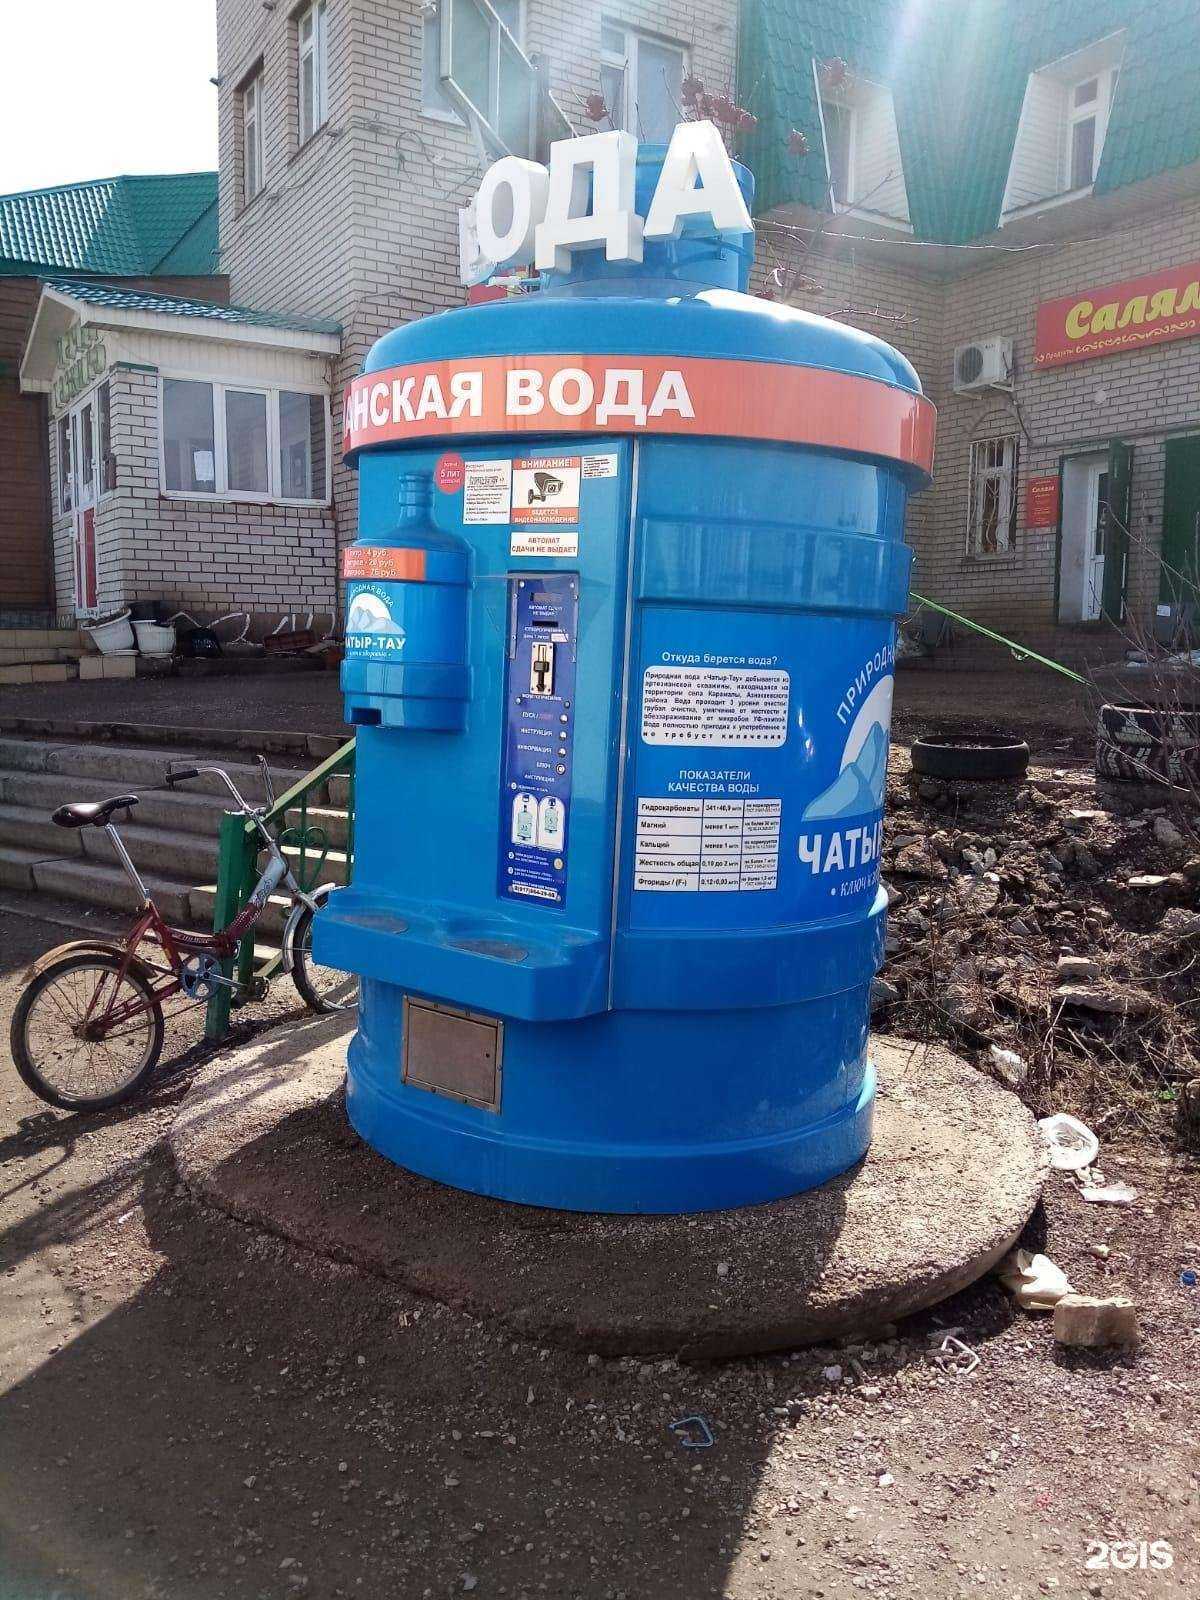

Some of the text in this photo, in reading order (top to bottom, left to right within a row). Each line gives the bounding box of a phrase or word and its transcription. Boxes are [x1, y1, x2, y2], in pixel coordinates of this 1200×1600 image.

[506, 368, 695, 426] ВОДА
[521, 459, 573, 469] ВНИМАНИЕ!
[662, 652, 778, 665] Откуда берется вода?
[646, 672, 681, 680] Природная
[836, 645, 895, 724] ПРИРОДН
[665, 731, 713, 739] требует
[679, 771, 750, 780] ПОКАЗАТЕЛИ
[668, 782, 760, 794] КАЧЕСТВА ВОДЫ
[641, 804, 700, 812] Гидрокарбонаты
[641, 821, 666, 829] Магний
[640, 841, 670, 849] Кальций
[639, 859, 676, 867] Жесткость
[677, 860, 699, 868] общая
[638, 878, 671, 886] Фториды
